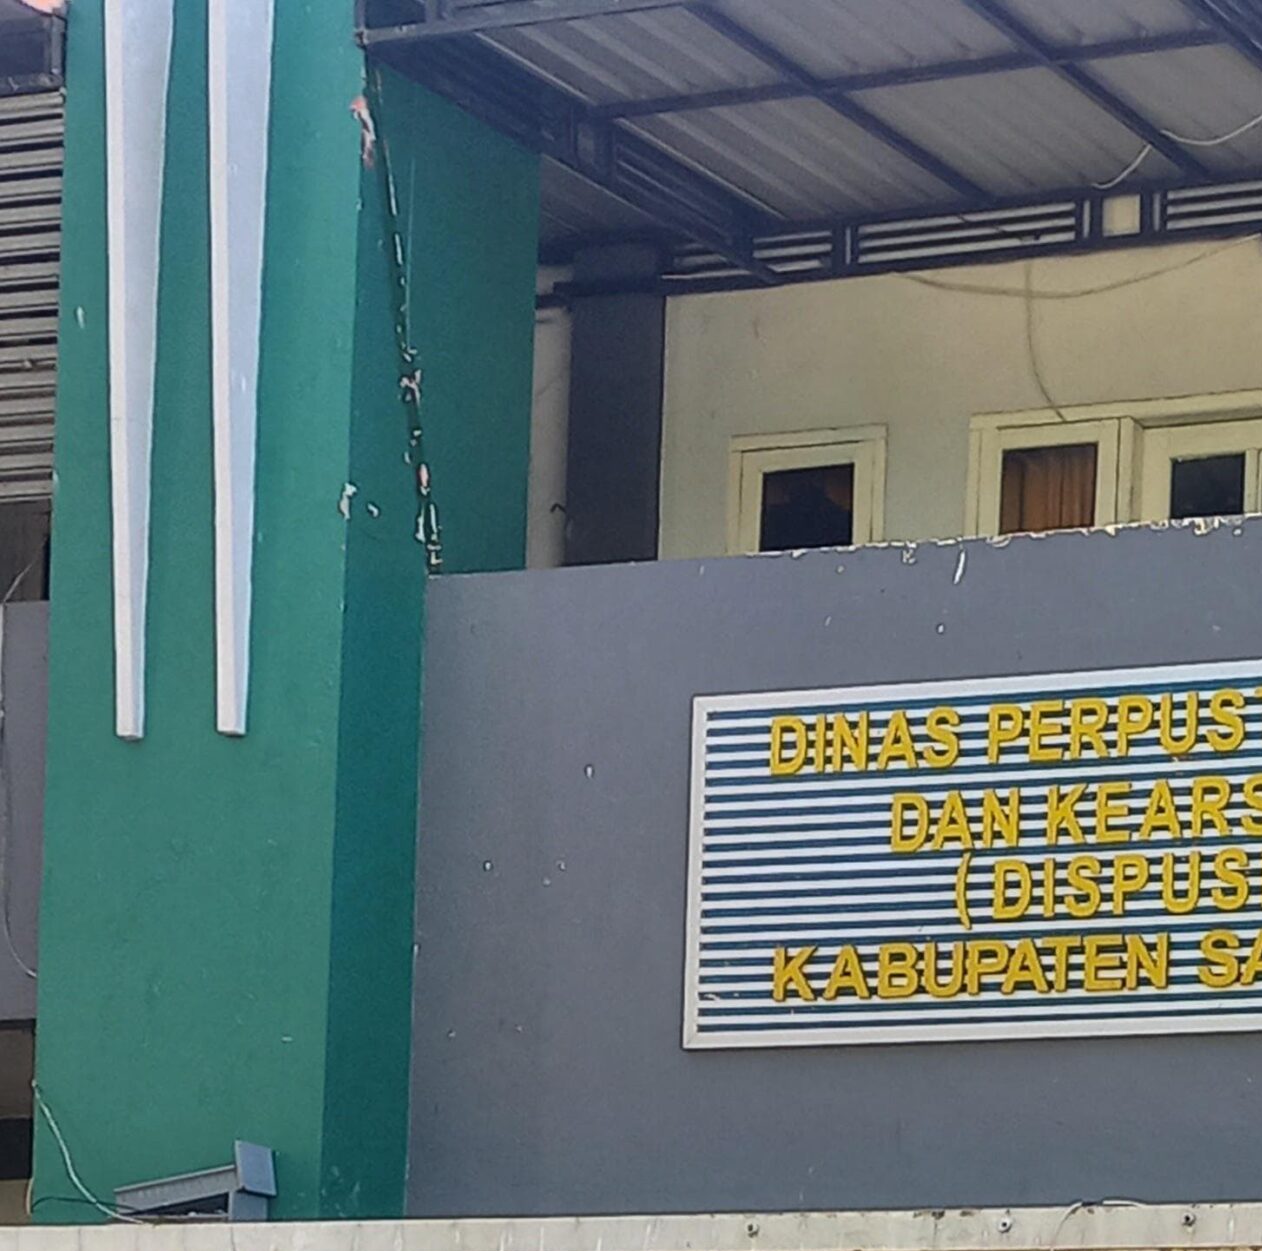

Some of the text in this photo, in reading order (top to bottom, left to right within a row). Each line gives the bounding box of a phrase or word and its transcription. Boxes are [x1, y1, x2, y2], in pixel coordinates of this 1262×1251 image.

[770, 708, 961, 777] DINAS
[890, 790, 1022, 854] DAN
[772, 934, 1170, 1004] KABUPATEN
